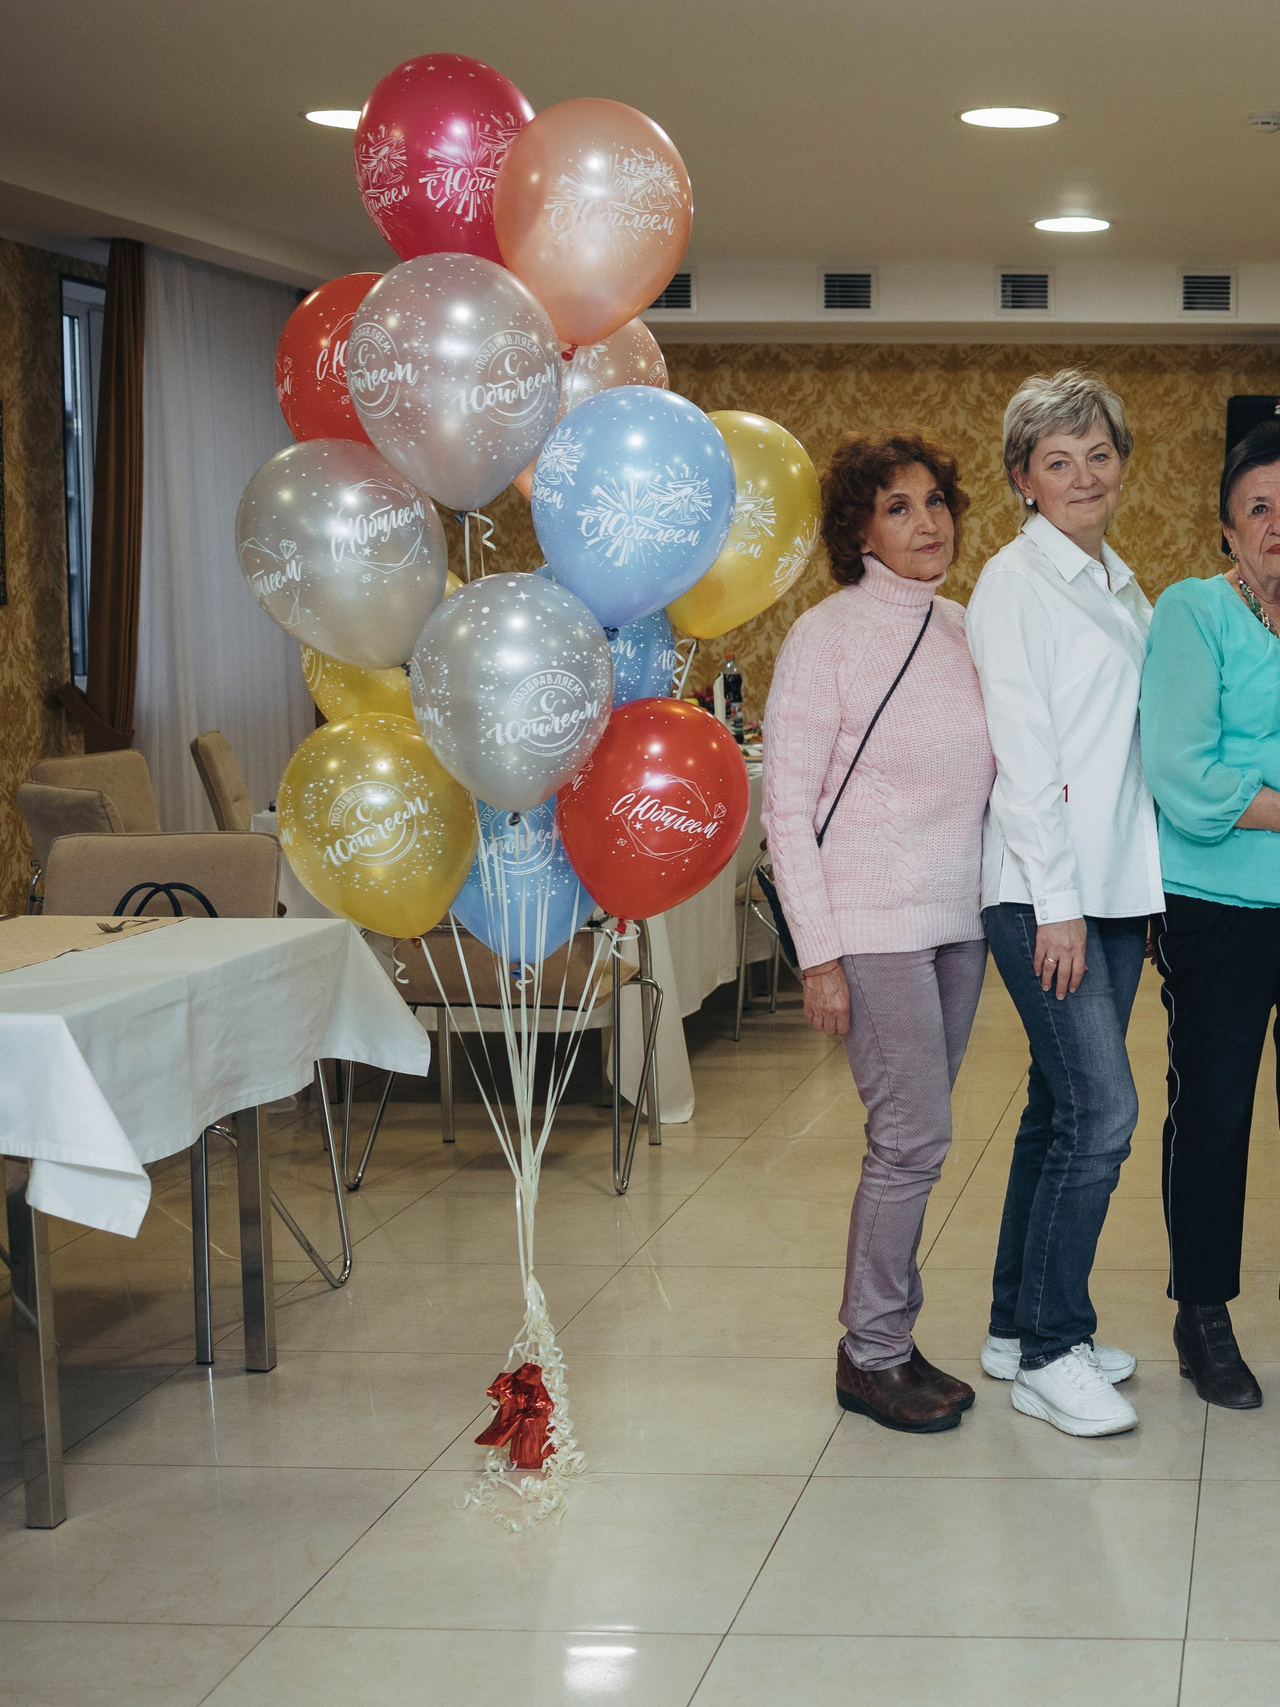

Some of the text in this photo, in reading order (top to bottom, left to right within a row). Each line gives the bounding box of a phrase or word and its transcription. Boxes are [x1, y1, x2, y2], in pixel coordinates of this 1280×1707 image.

[474, 334, 541, 371] ПОЗДРАВЛЯЕМ
[450, 362, 558, 417] Юбилеем
[348, 499, 425, 555] Юбилеем
[599, 509, 700, 547] Юбилеем
[510, 674, 582, 707] ПОЗДРАВЛЯЕМ
[486, 699, 601, 746] Юбилеем
[323, 796, 429, 867] Юбилеем
[627, 795, 721, 839] Юбилеем
